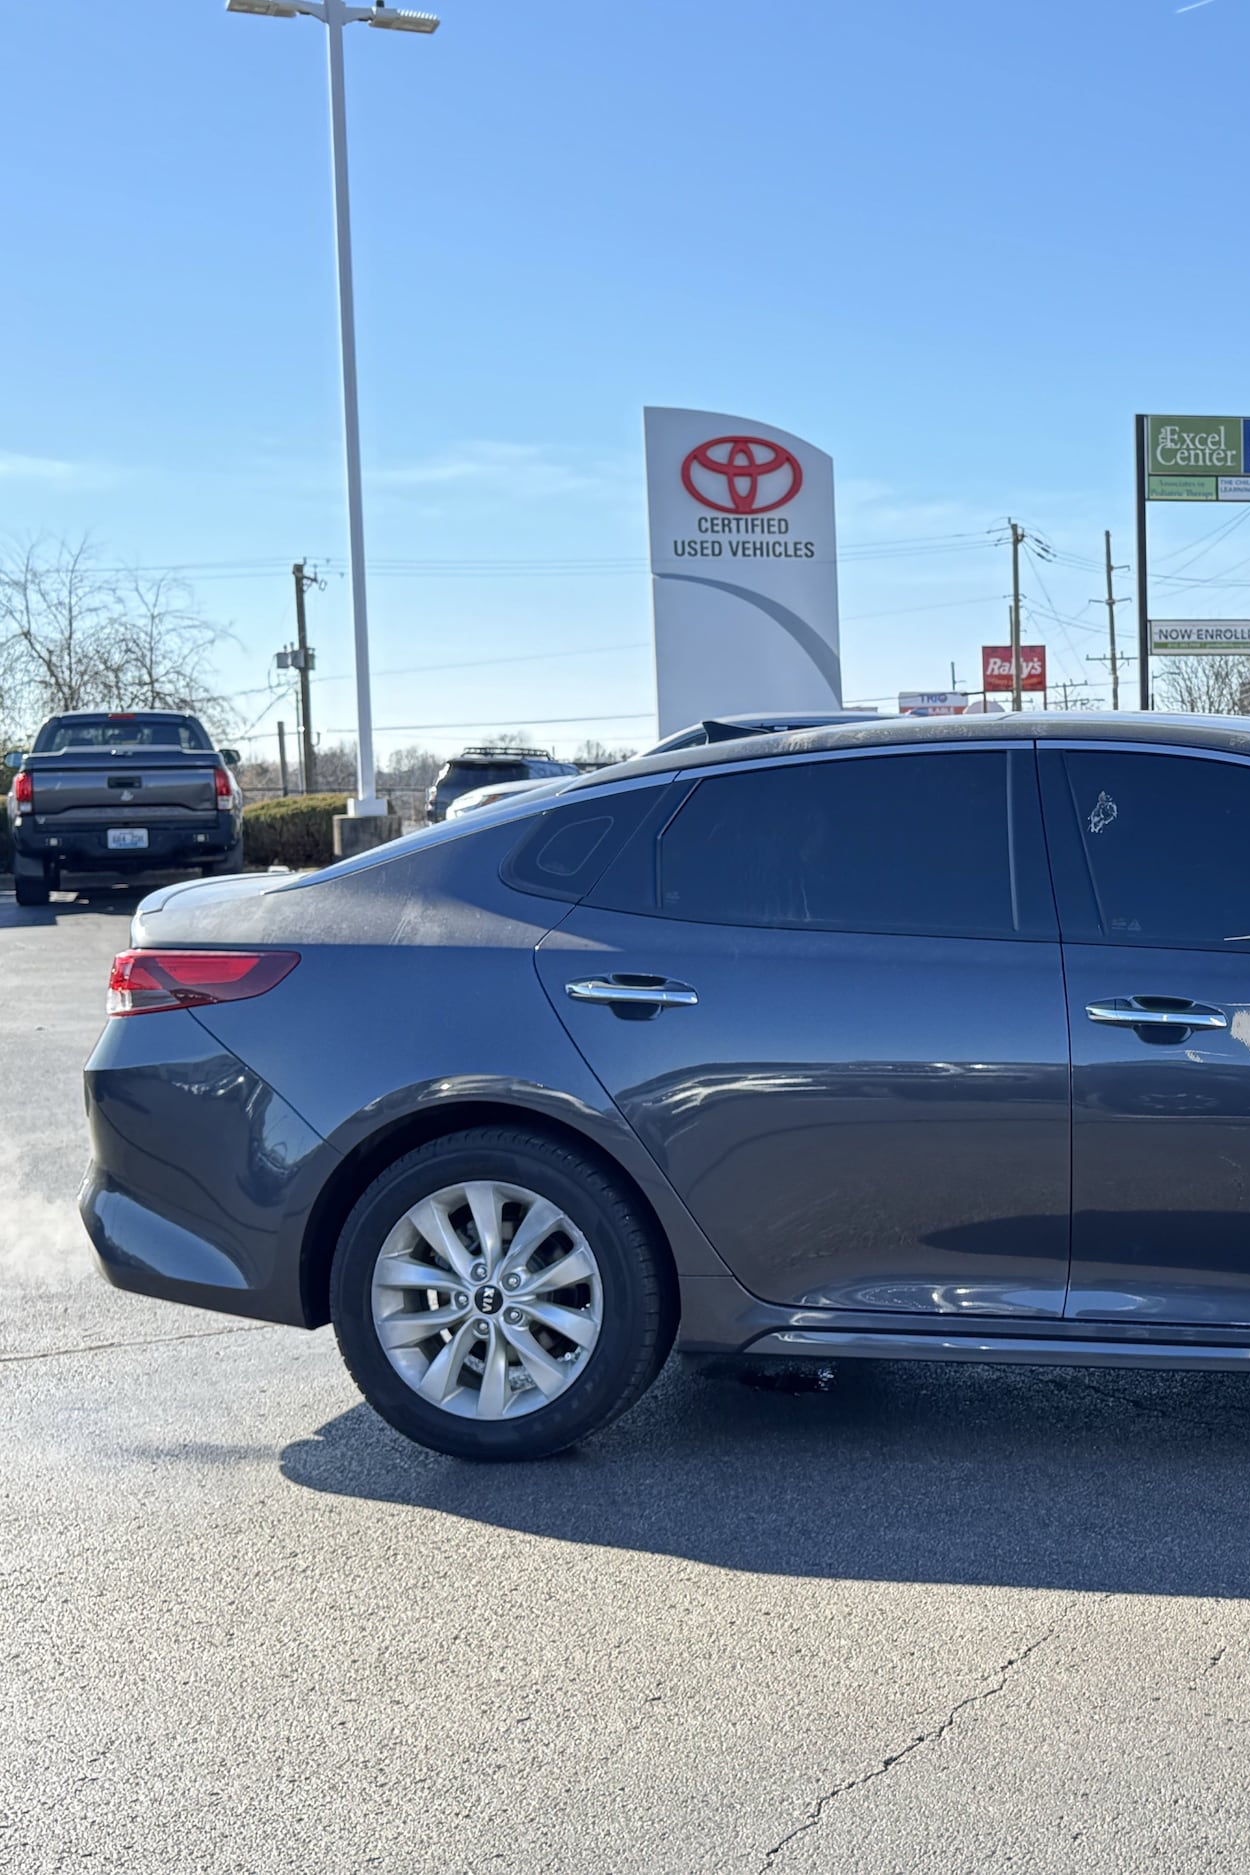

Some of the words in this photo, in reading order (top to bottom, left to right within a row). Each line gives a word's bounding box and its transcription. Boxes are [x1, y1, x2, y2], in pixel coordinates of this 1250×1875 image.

[1164, 425, 1227, 450] Excel
[1156, 443, 1237, 466] Center
[697, 516, 789, 535] CERTIFIED
[673, 540, 723, 557] USED
[728, 540, 815, 559] VEHICLES
[1158, 628, 1193, 640] NOW
[482, 1287, 495, 1312] KIA
